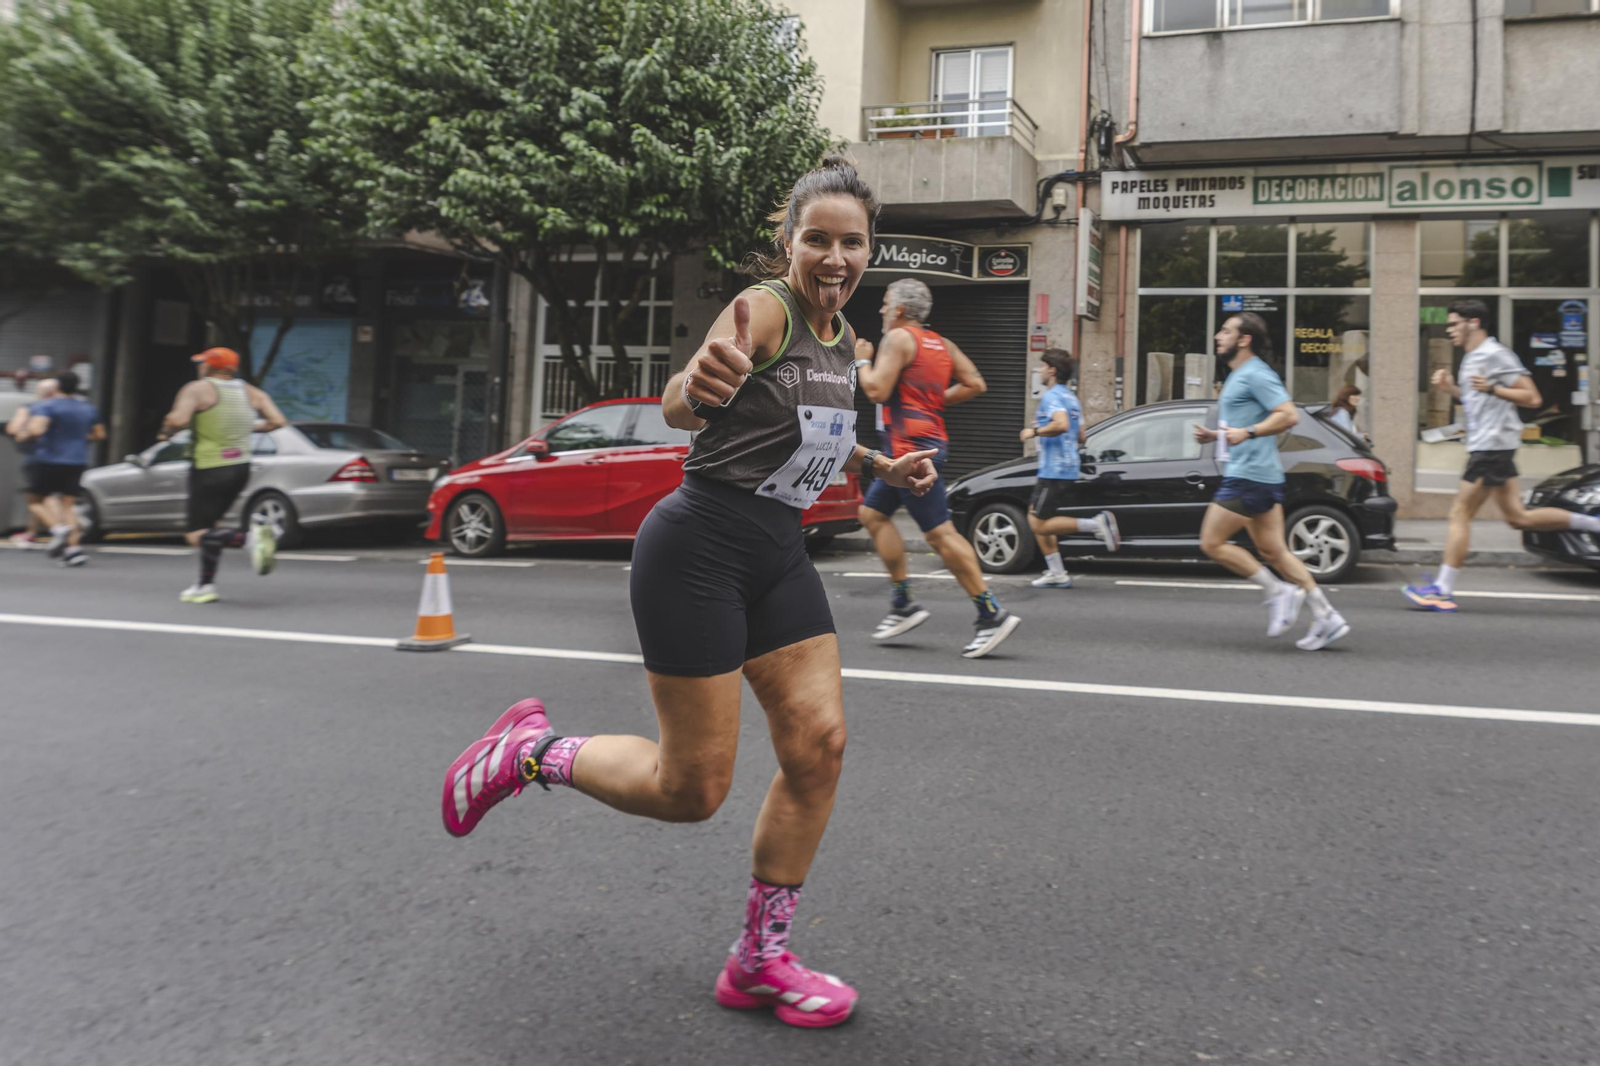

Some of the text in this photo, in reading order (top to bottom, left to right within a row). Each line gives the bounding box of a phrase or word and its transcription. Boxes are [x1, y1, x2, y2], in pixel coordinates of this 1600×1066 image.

[1111, 176, 1246, 194] PAPELES PINTADOS
[1257, 176, 1381, 202] DECORACION
[1396, 171, 1534, 201] alonso
[1137, 194, 1216, 212] MOQUETAS
[874, 244, 948, 269] Mágico
[1295, 328, 1334, 338] REGALA
[791, 456, 837, 492] 149
